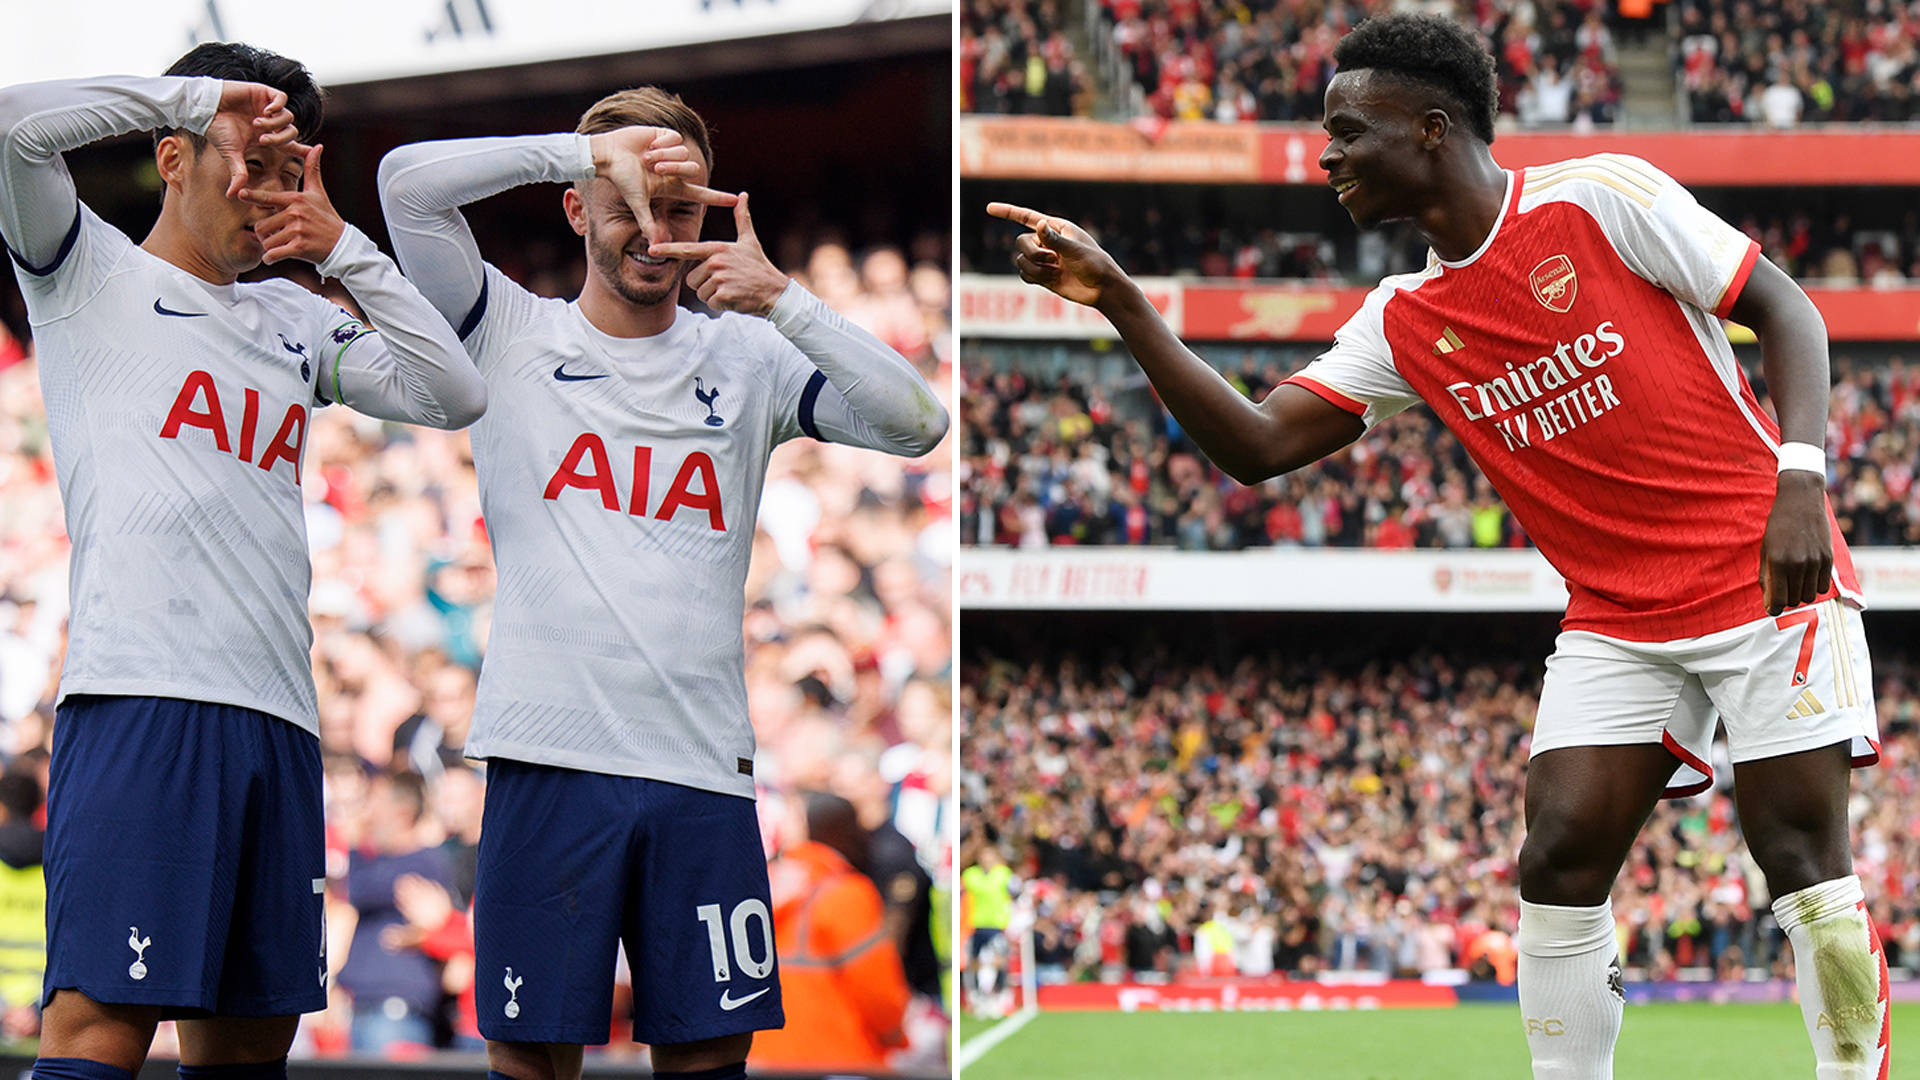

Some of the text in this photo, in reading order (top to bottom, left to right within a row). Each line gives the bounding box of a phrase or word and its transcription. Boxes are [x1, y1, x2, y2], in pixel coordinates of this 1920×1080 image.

[1536, 261, 1569, 285] Arsenal
[1446, 321, 1625, 422] Emirates
[1533, 373, 1621, 441] BETTER
[159, 369, 307, 487] AIA
[543, 432, 727, 532] AIA
[1775, 607, 1819, 687] 7
[696, 898, 774, 983] 10
